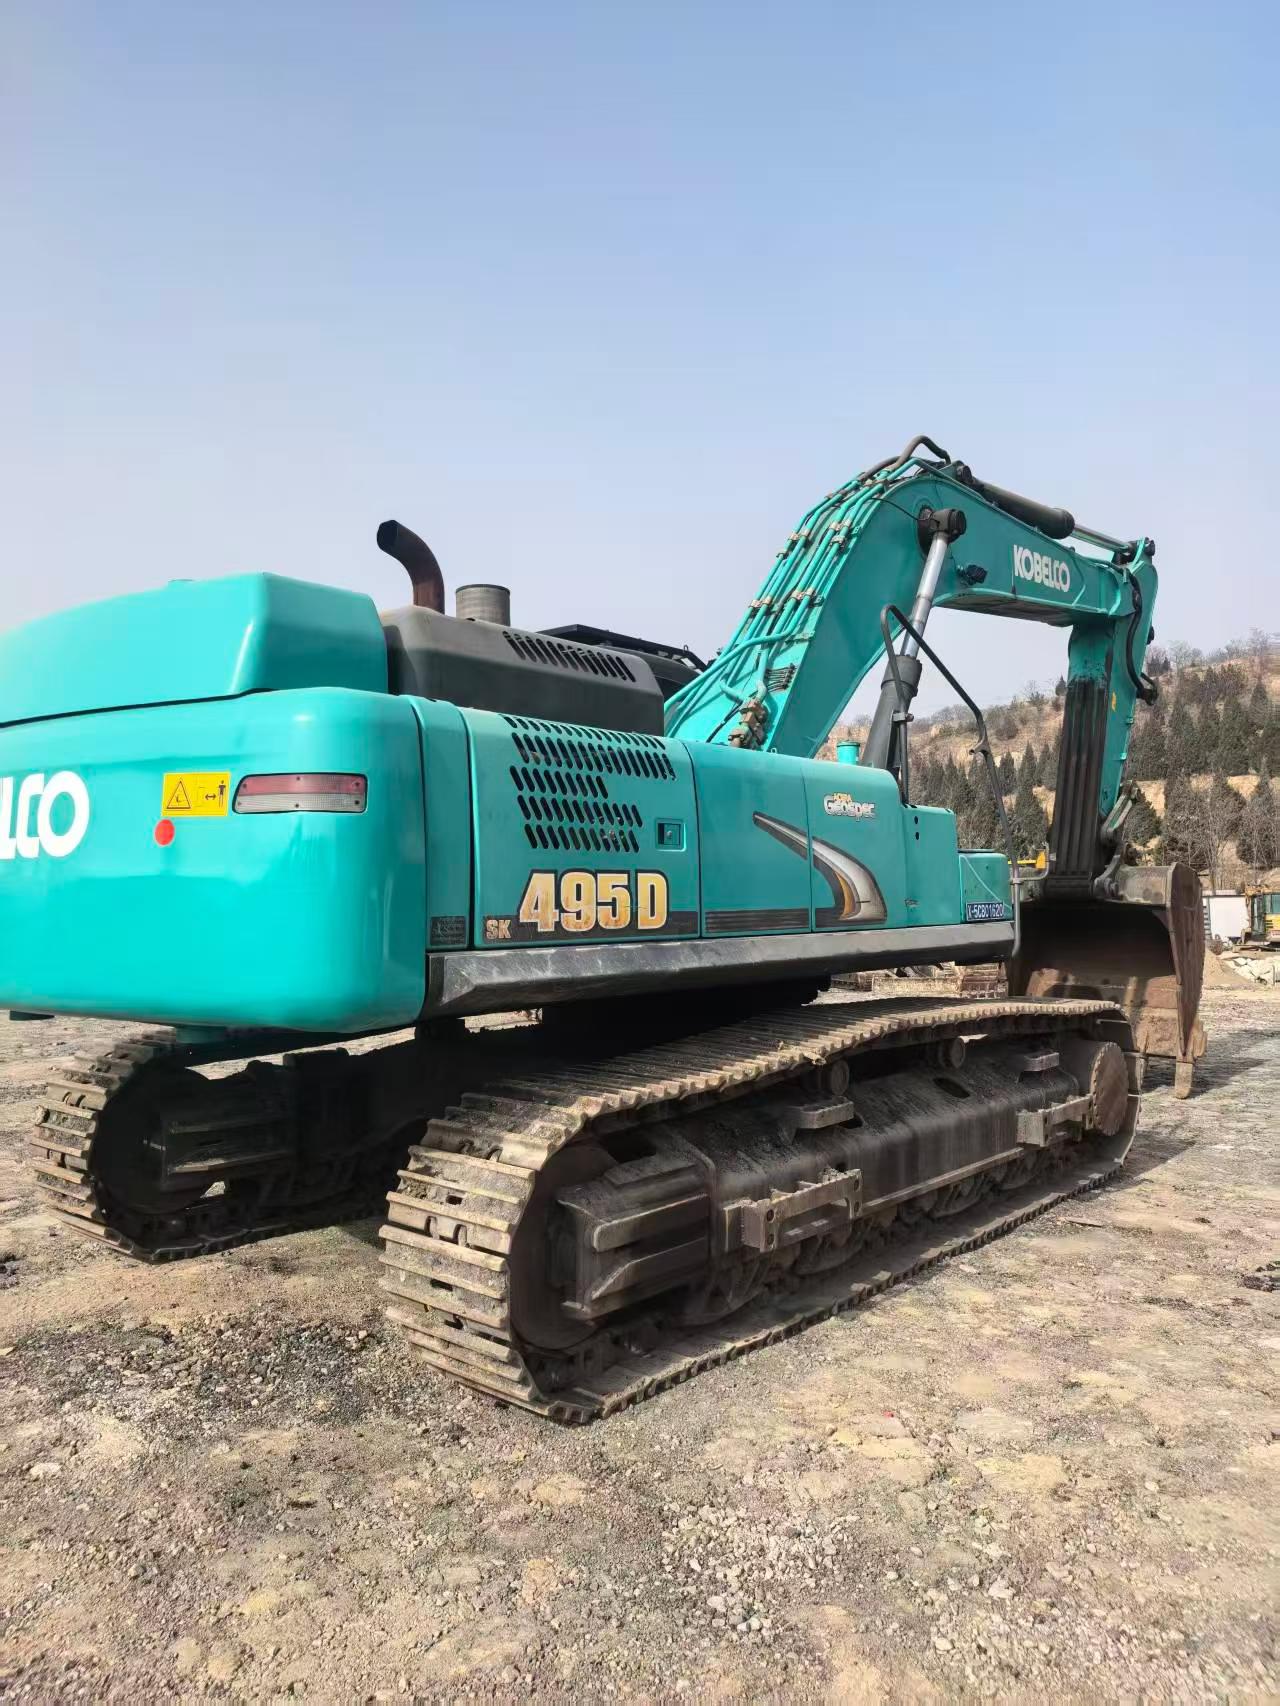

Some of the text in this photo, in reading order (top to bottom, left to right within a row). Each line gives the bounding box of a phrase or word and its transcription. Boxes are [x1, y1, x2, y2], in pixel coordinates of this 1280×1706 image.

[1013, 544, 1071, 592] KOBELCO
[0, 770, 90, 860] LCO
[486, 919, 511, 940] SK
